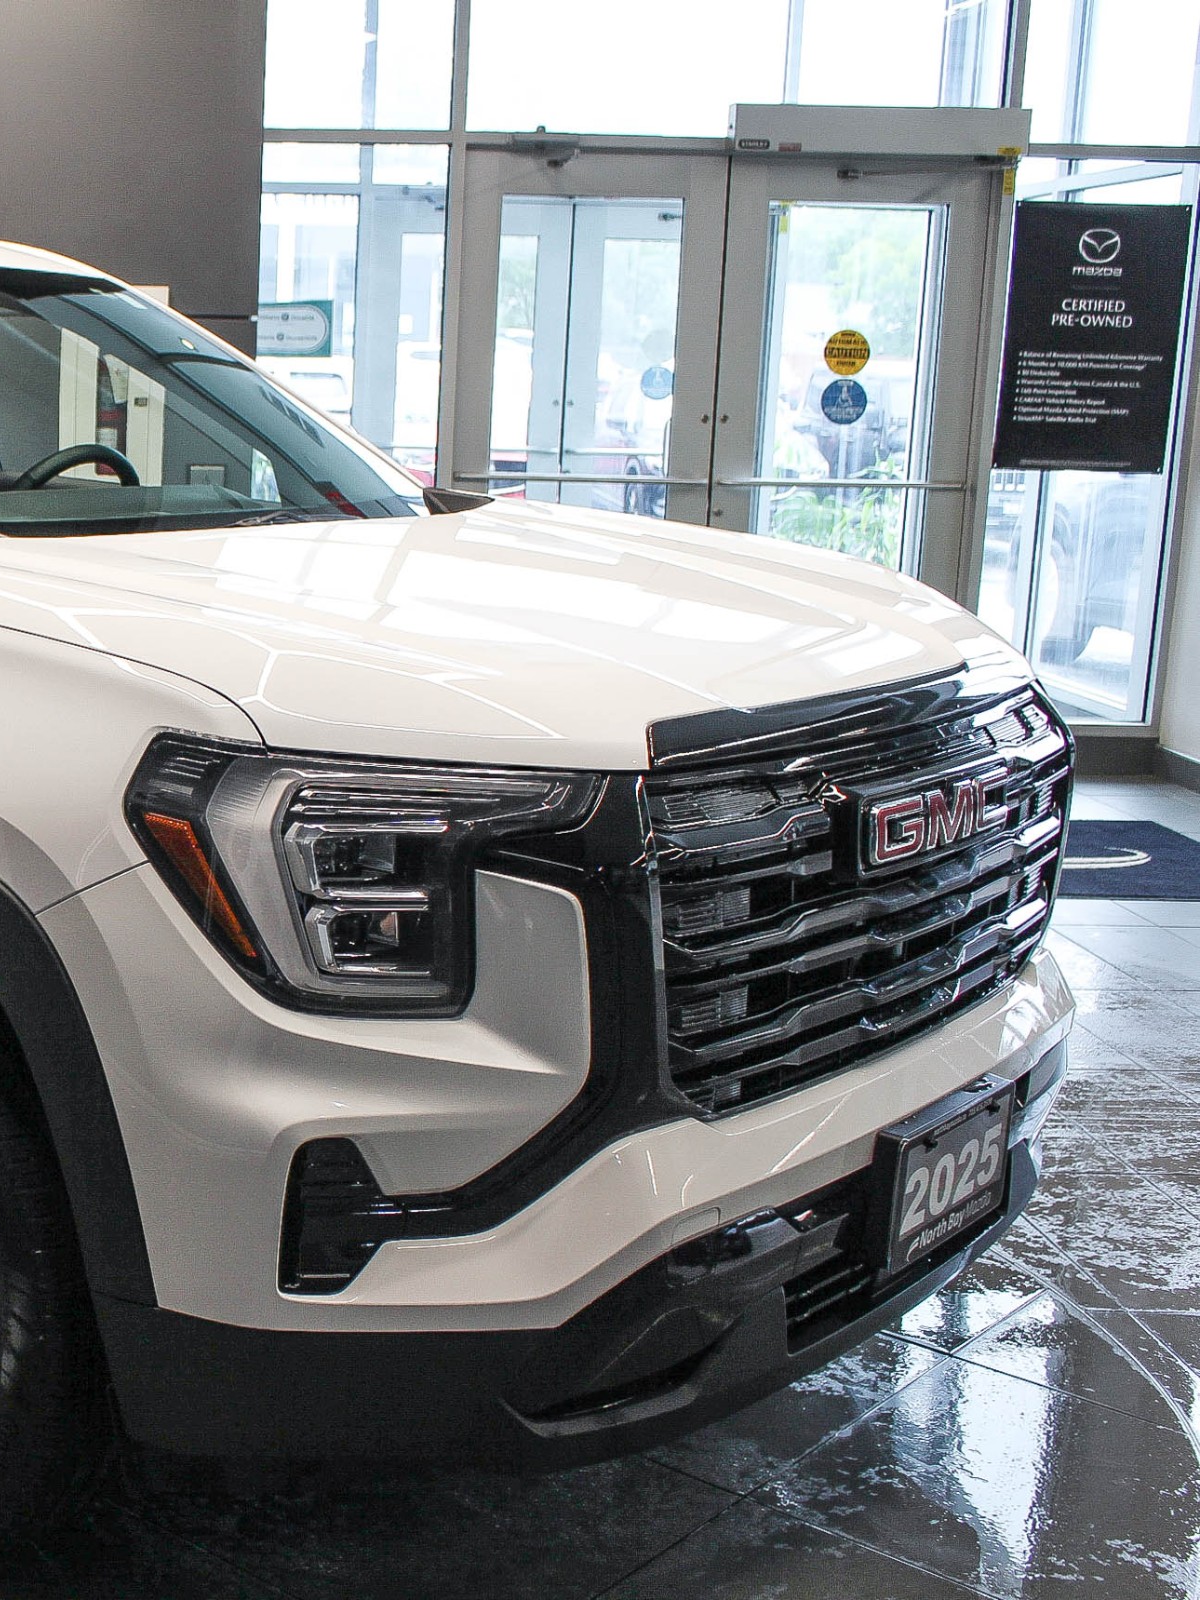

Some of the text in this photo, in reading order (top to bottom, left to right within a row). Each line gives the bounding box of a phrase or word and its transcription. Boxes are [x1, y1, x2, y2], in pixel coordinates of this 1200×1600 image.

[1072, 266, 1122, 277] mazda
[1061, 298, 1126, 312] CERTIFIED
[1051, 313, 1133, 328] PRE-OWNED
[825, 347, 868, 359] CAUTION
[1138, 354, 1163, 362] Warranty
[870, 766, 1010, 865] GMC
[899, 1123, 1003, 1236] 2025
[918, 1220, 948, 1249] North
[948, 1209, 965, 1233] Bay
